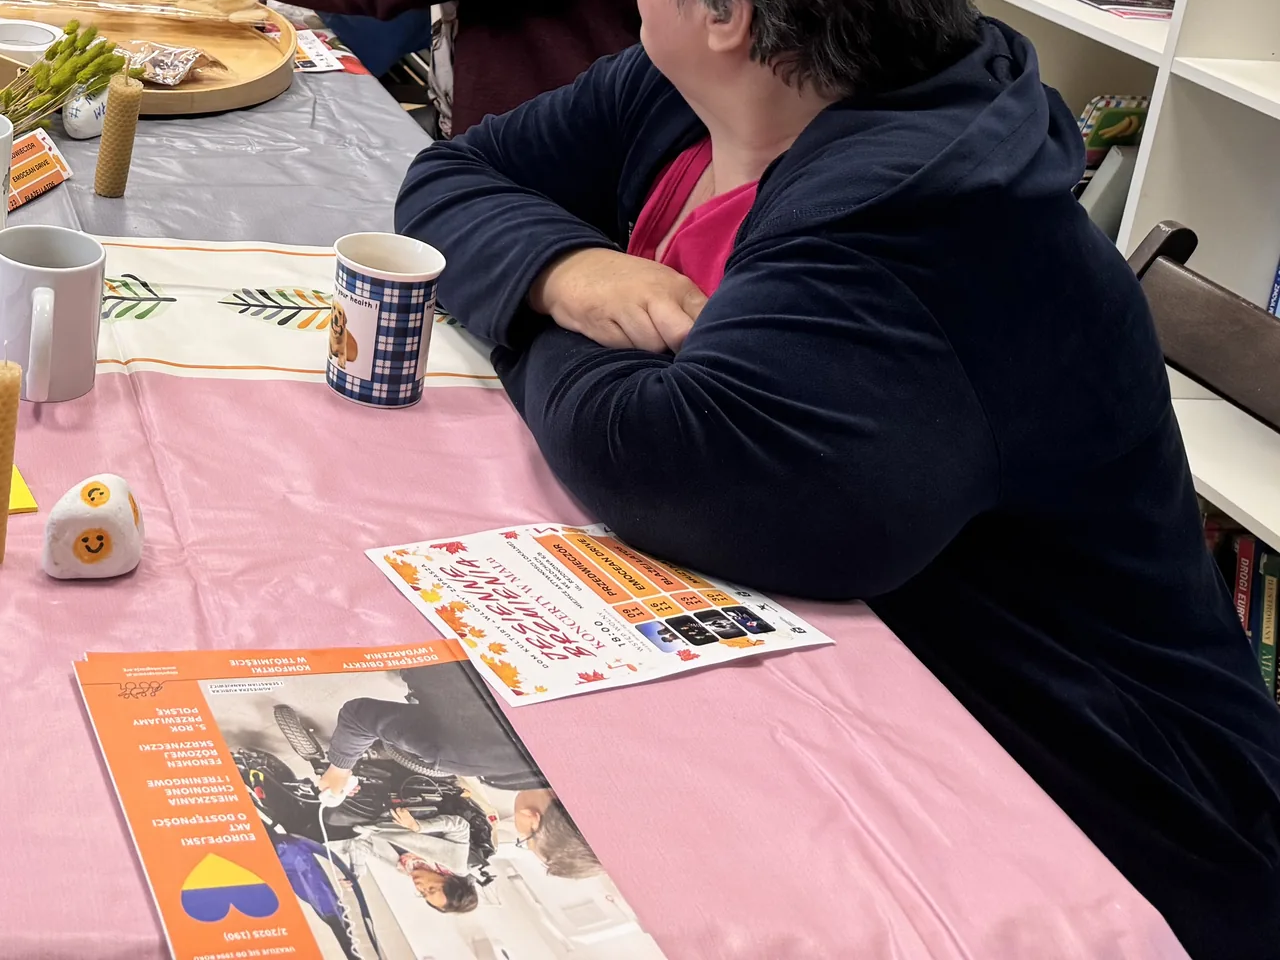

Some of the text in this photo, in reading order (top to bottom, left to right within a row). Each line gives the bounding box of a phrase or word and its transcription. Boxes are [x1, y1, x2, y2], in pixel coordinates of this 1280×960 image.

[12, 159, 50, 183] EMOCEAN DRIVE
[349, 294, 373, 309] health
[550, 543, 617, 595] PRZEDWIECZÓR
[575, 538, 646, 590] EMOCEAN DRIVE
[421, 563, 457, 594] ZAPRASZA
[1238, 557, 1249, 590] DROGI
[688, 595, 702, 604] 11
[713, 592, 728, 601] 11
[455, 556, 597, 658] BRZMIENIA
[485, 556, 607, 651] KONCERTY W MALu
[649, 602, 664, 612] 16
[657, 600, 672, 610] 11
[439, 565, 570, 660] JESIENNE
[621, 608, 637, 617] 09
[630, 607, 645, 615] 11
[495, 624, 531, 654] KULTURY
[594, 620, 626, 648] 18:00
[363, 647, 429, 661] WYDARZENIA
[229, 657, 296, 667] TRÓJMIEŚCIE
[342, 654, 439, 670] DOSTĘPNE OBIEKTY
[531, 653, 549, 670] DOM
[251, 664, 311, 675] KOMFORTKI
[155, 707, 199, 716] POLSKĘ
[133, 715, 202, 726] PRZEWIJAMY
[171, 724, 194, 732] ROK
[139, 740, 214, 752] SKRZYNECZKI
[164, 749, 218, 759] RÓŻOWEJ
[167, 759, 222, 768] FENOMEN
[146, 775, 225, 788] TRENINGOWE
[164, 785, 234, 796] CHRONIONE
[168, 794, 239, 806] MIESZKANIA
[151, 812, 247, 827] O DOSTĘPNOŚCI
[229, 823, 251, 831] AKT
[181, 833, 256, 846] EUROPEJSKI
[223, 927, 289, 942] 2/2025 (190)
